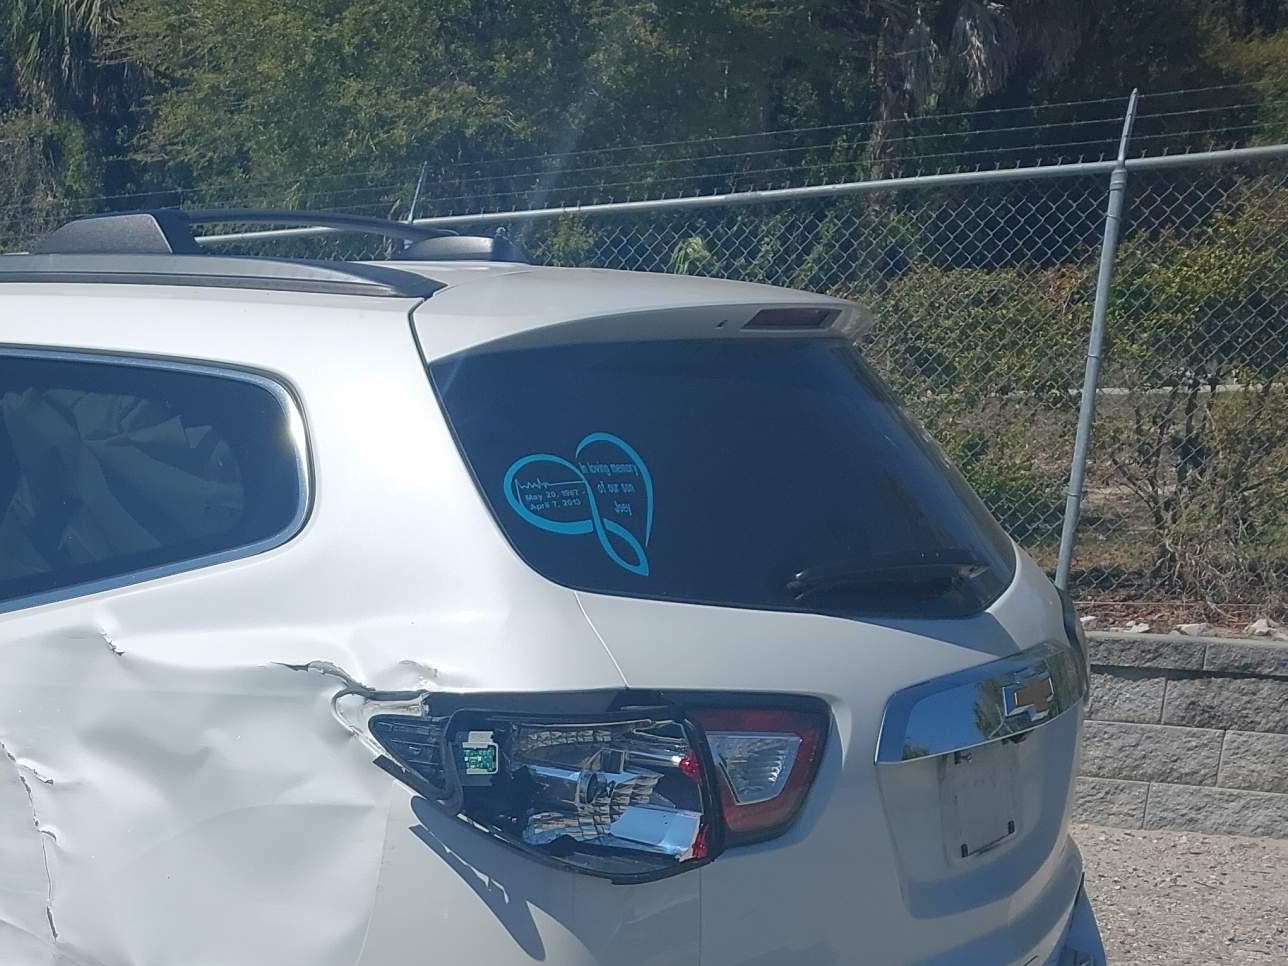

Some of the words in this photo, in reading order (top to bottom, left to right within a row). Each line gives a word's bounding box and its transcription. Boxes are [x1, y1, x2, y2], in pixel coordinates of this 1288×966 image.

[589, 462, 610, 476] loving
[610, 463, 639, 476] memory
[597, 481, 606, 494] of
[607, 483, 620, 494] our
[621, 483, 635, 493] son
[524, 494, 543, 502] May
[530, 501, 550, 511] April
